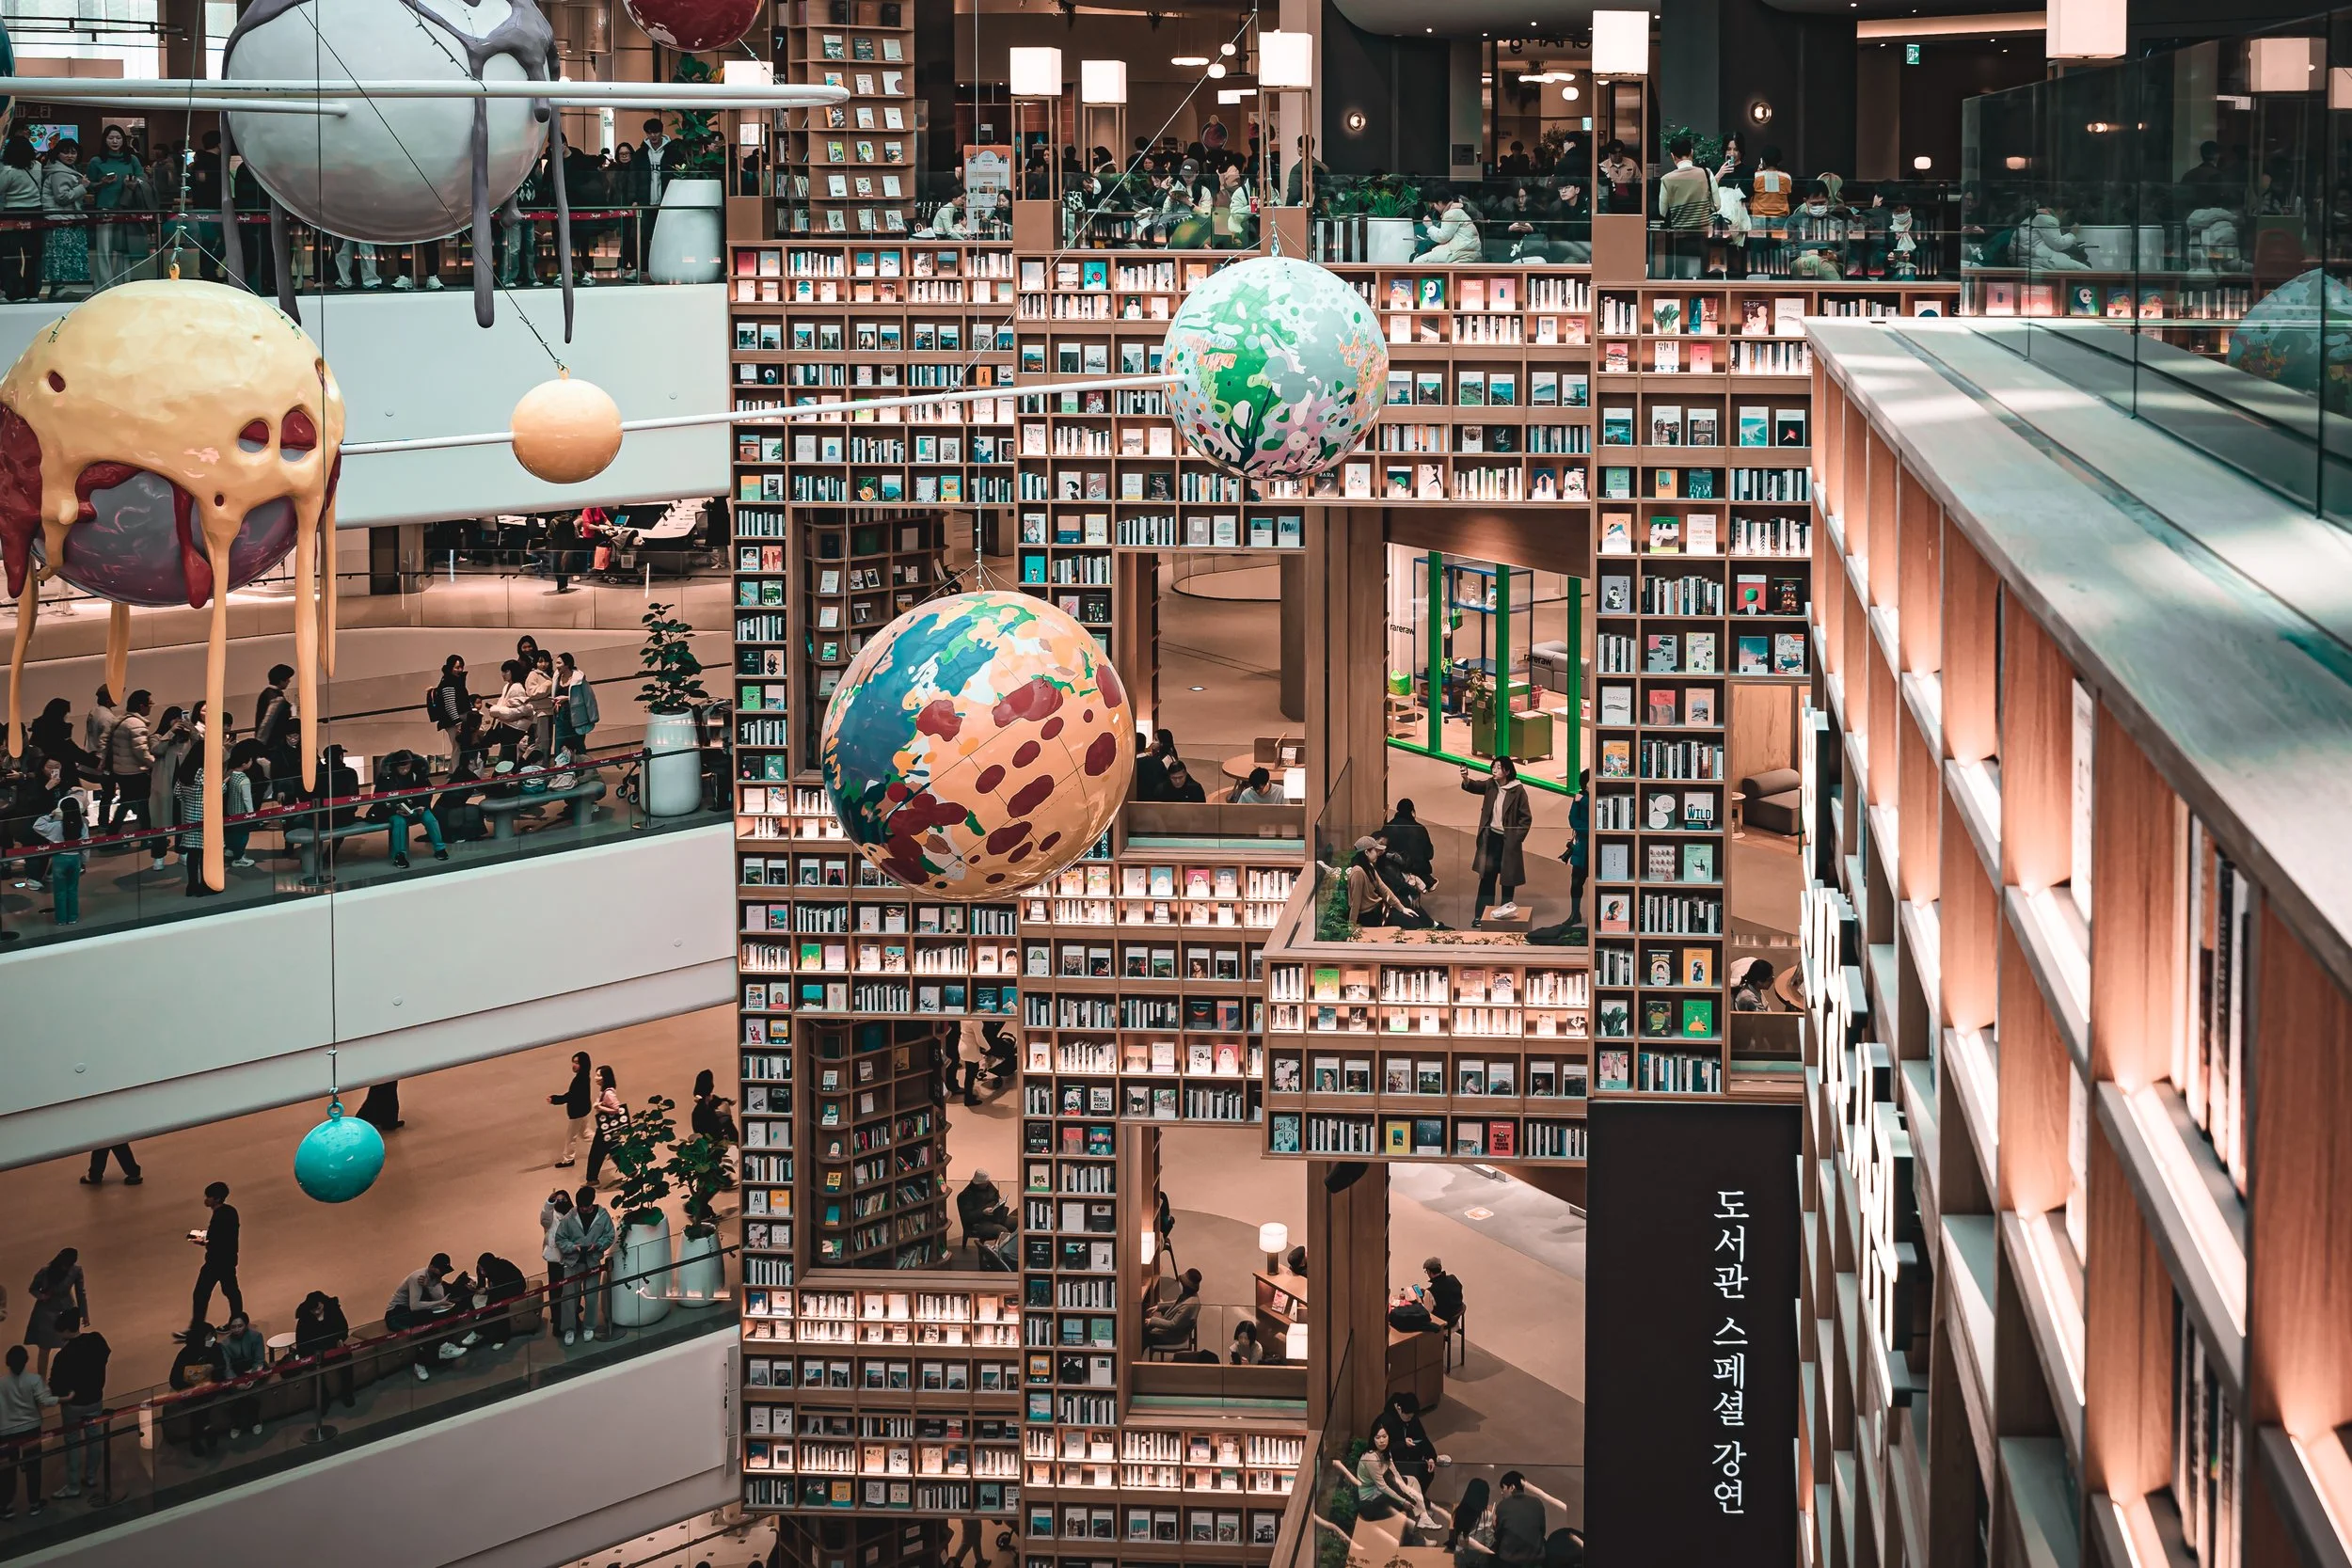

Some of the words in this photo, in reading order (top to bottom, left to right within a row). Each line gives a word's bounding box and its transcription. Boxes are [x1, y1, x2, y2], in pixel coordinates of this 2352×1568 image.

[775, 37, 784, 49] 7
[1390, 624, 1415, 635] rareraw
[1687, 807, 1711, 820] WILD
[1713, 1190, 1749, 1299] 도서관
[1712, 1317, 1748, 1426] 스페셜
[1712, 1440, 1747, 1514] 강연
